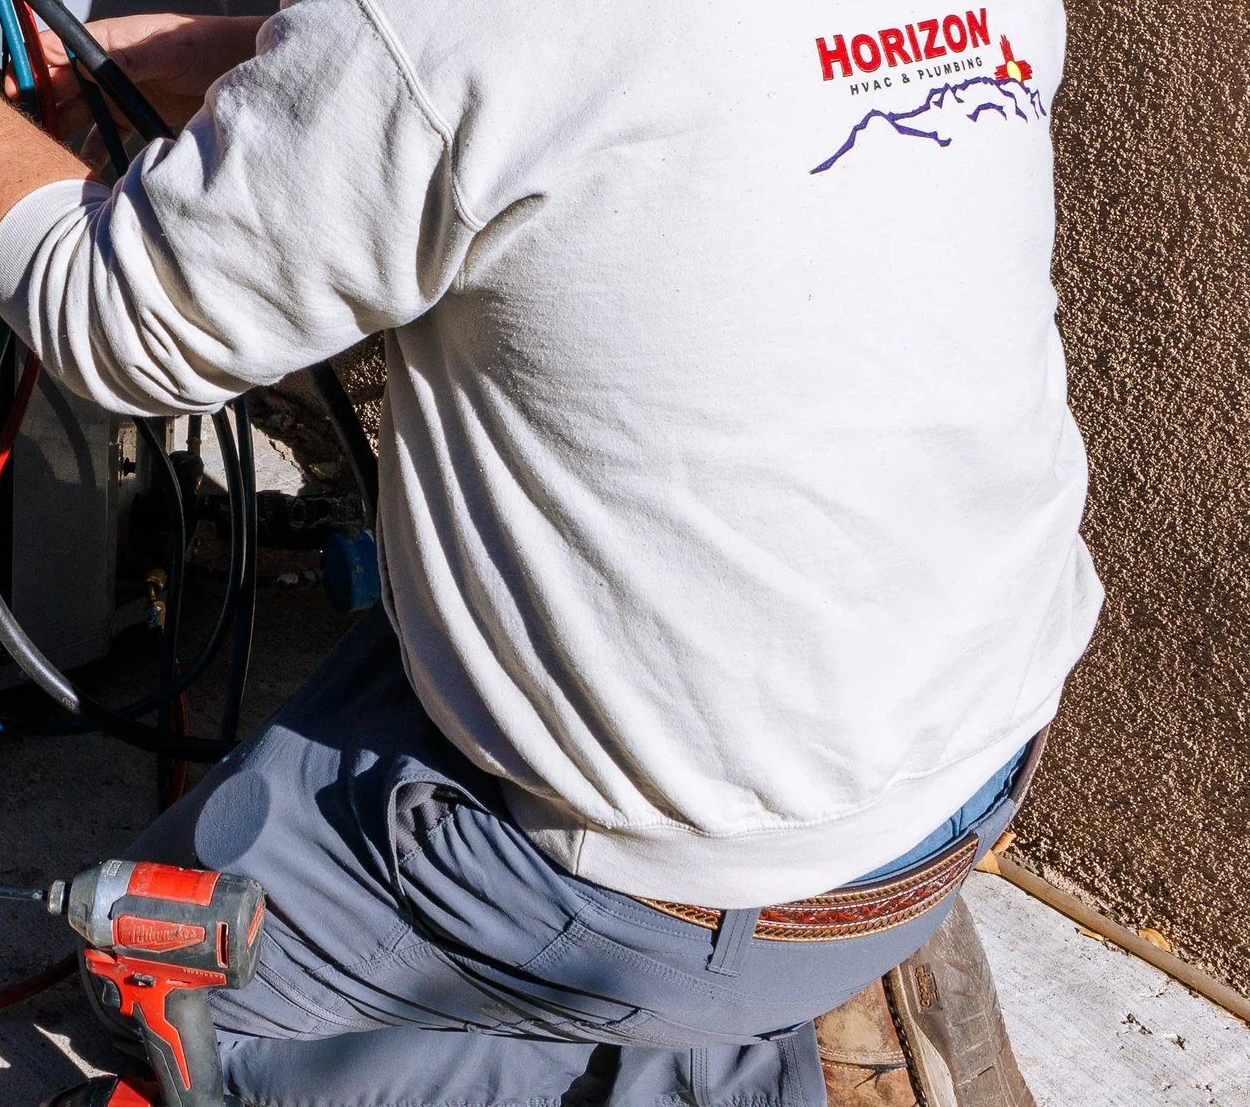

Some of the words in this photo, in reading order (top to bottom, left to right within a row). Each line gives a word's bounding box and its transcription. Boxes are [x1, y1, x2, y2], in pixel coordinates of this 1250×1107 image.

[816, 8, 991, 81] HORIZON
[850, 77, 893, 95] HVAC
[902, 73, 911, 83] &
[918, 56, 983, 80] PLUMBING
